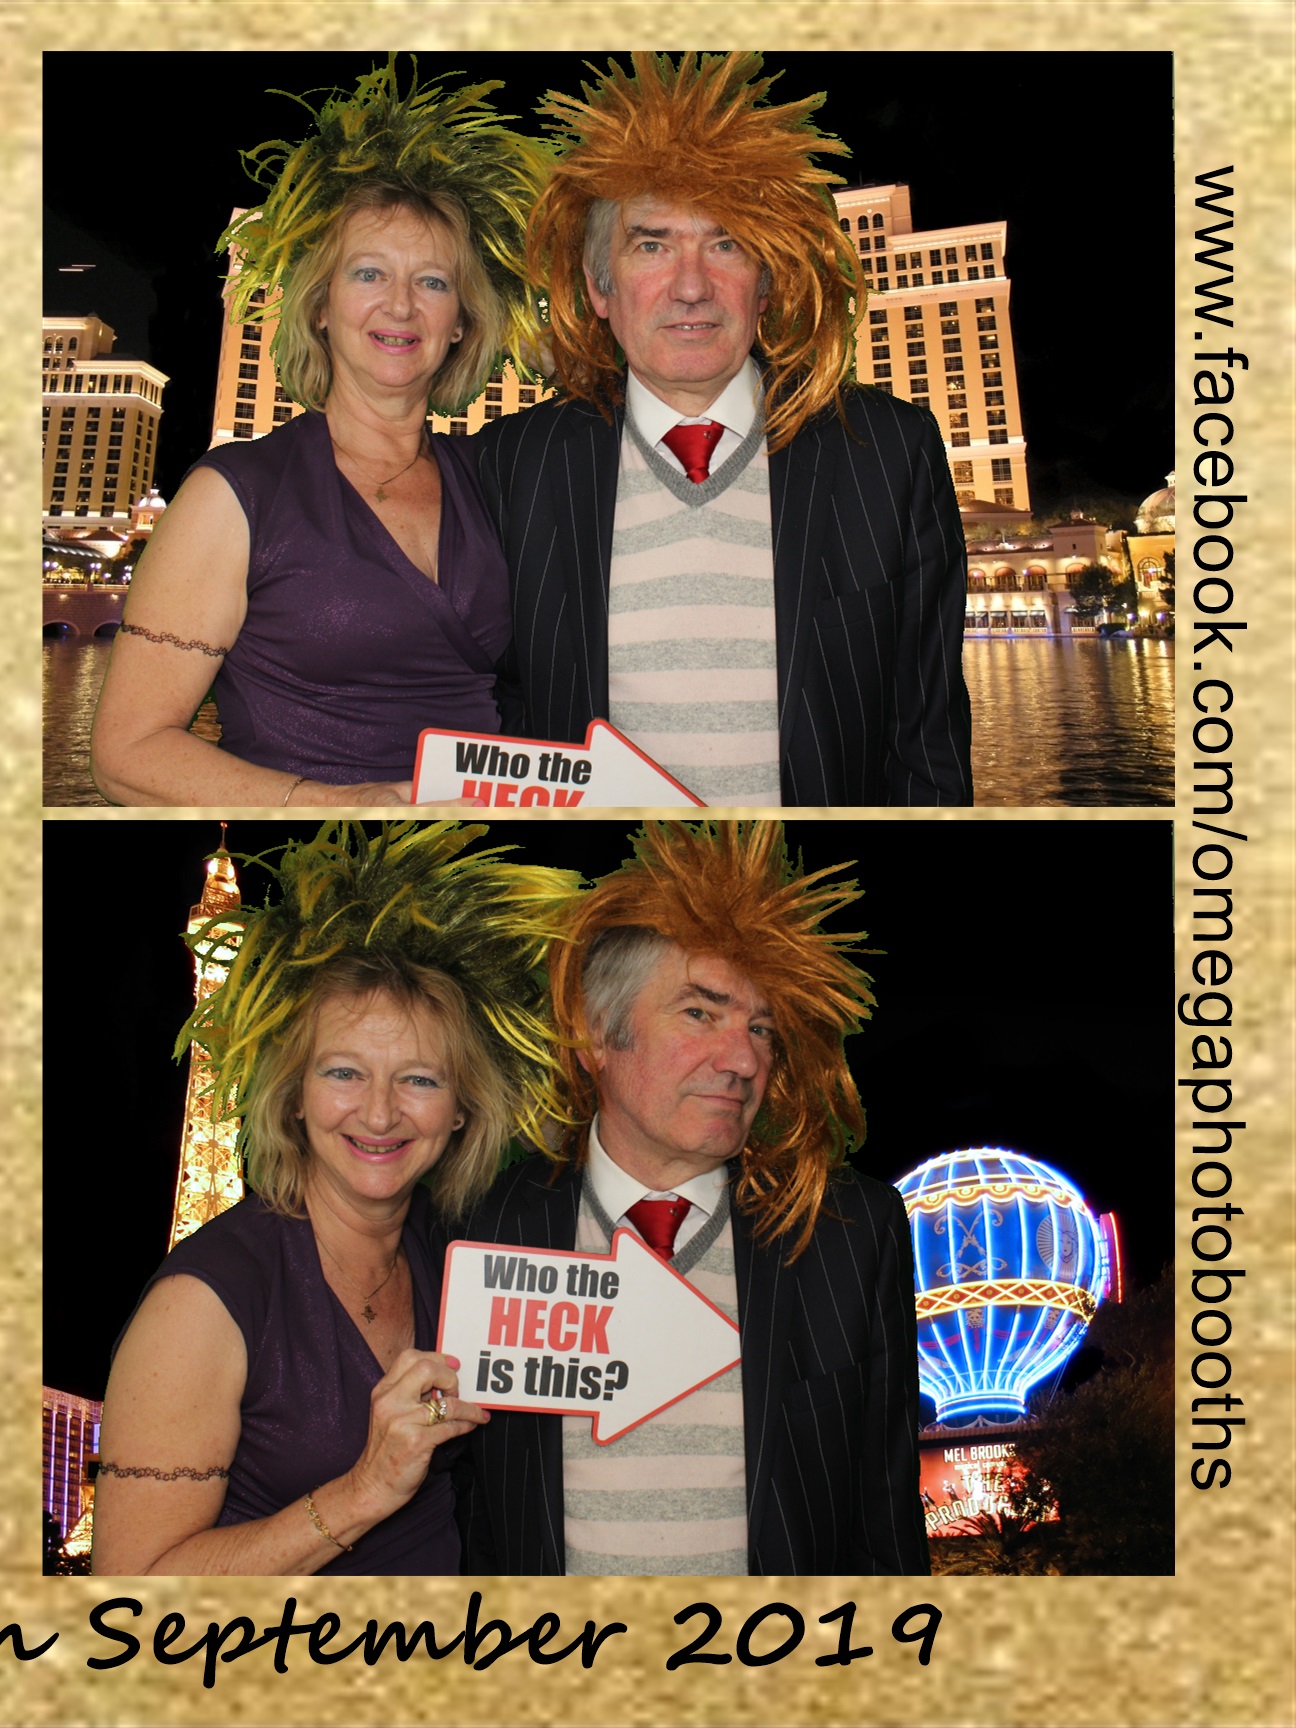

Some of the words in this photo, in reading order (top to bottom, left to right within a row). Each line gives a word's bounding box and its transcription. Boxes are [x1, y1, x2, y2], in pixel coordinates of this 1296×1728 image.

[455, 741, 531, 779] Who
[538, 752, 592, 786] the
[483, 1254, 559, 1294] Who
[566, 1263, 620, 1300] the
[487, 1295, 615, 1355] HECK
[475, 1350, 514, 1394] is
[524, 1355, 630, 1401] this?
[944, 1448, 968, 1463] MEL
